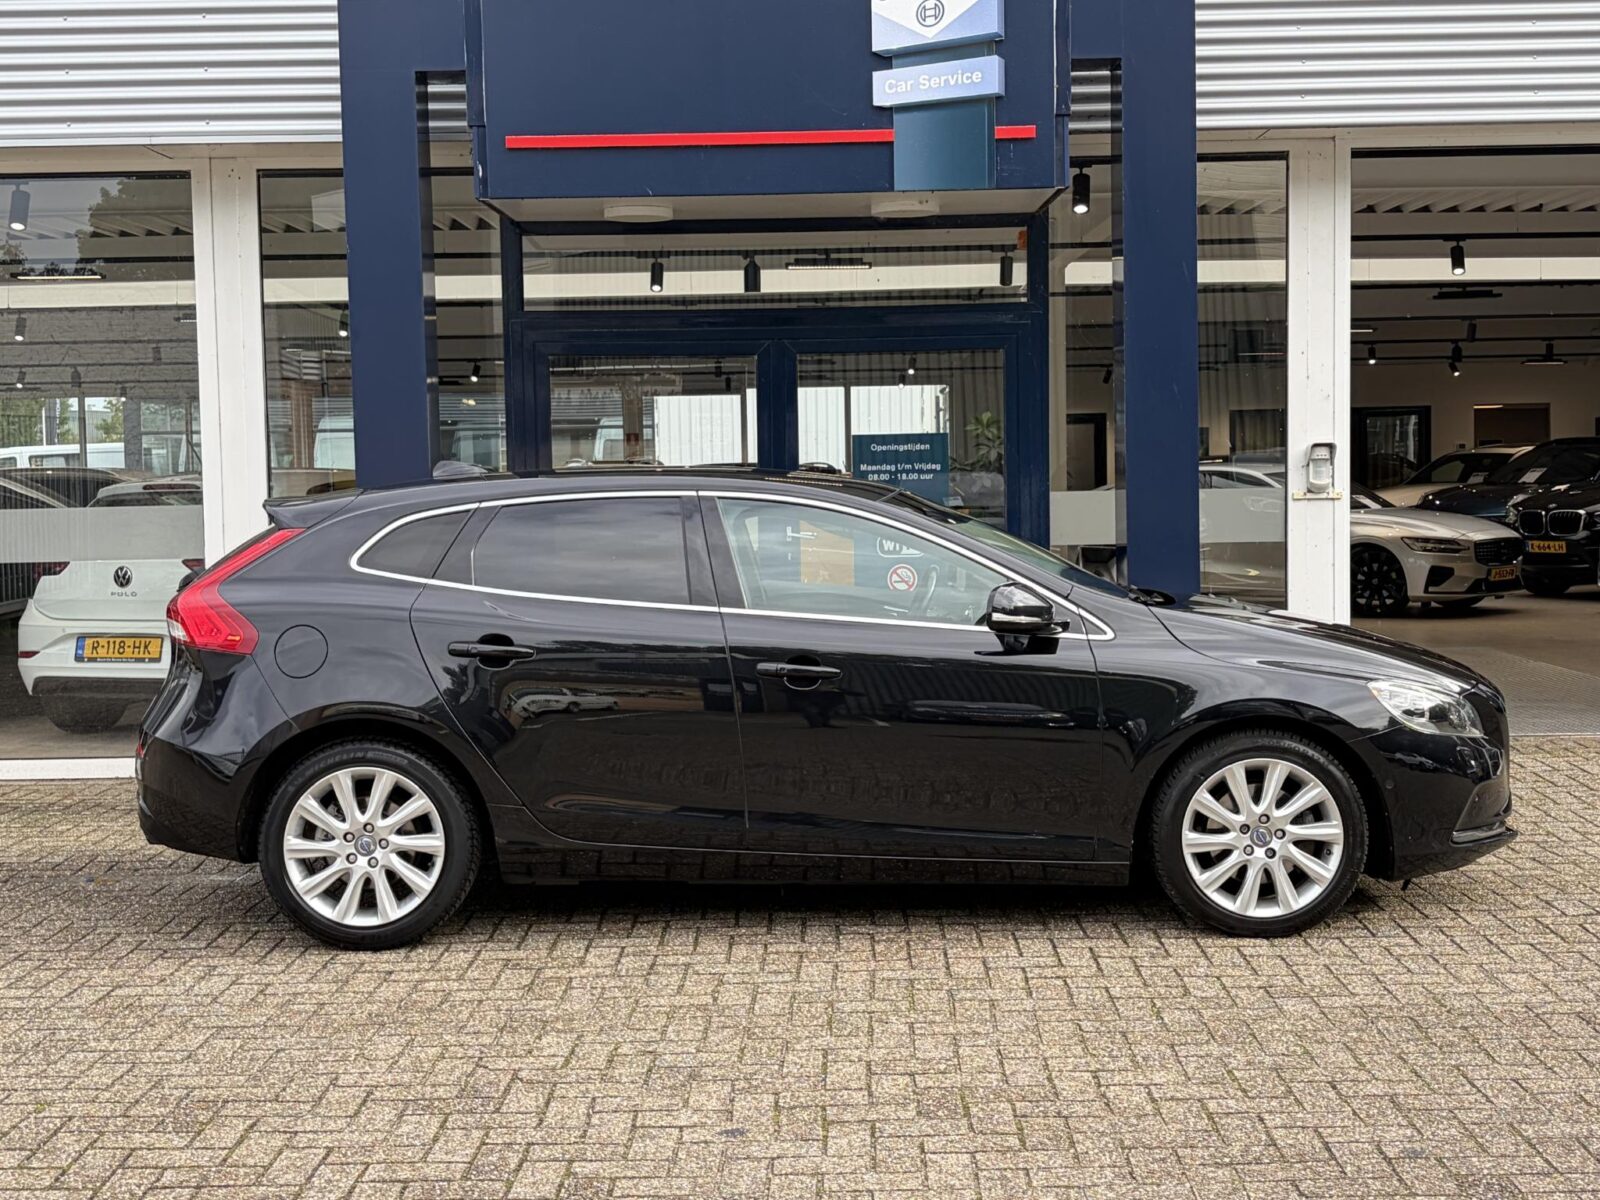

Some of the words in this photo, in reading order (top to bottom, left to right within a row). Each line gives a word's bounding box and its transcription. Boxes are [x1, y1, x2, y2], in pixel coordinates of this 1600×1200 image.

[885, 79, 914, 94] Car
[919, 70, 982, 90] Service
[871, 444, 930, 452] Openingstijden
[860, 463, 896, 472] Maandag
[897, 463, 912, 471] t/m
[914, 462, 941, 471] Vrijdag
[90, 640, 152, 656] R-118-HK
